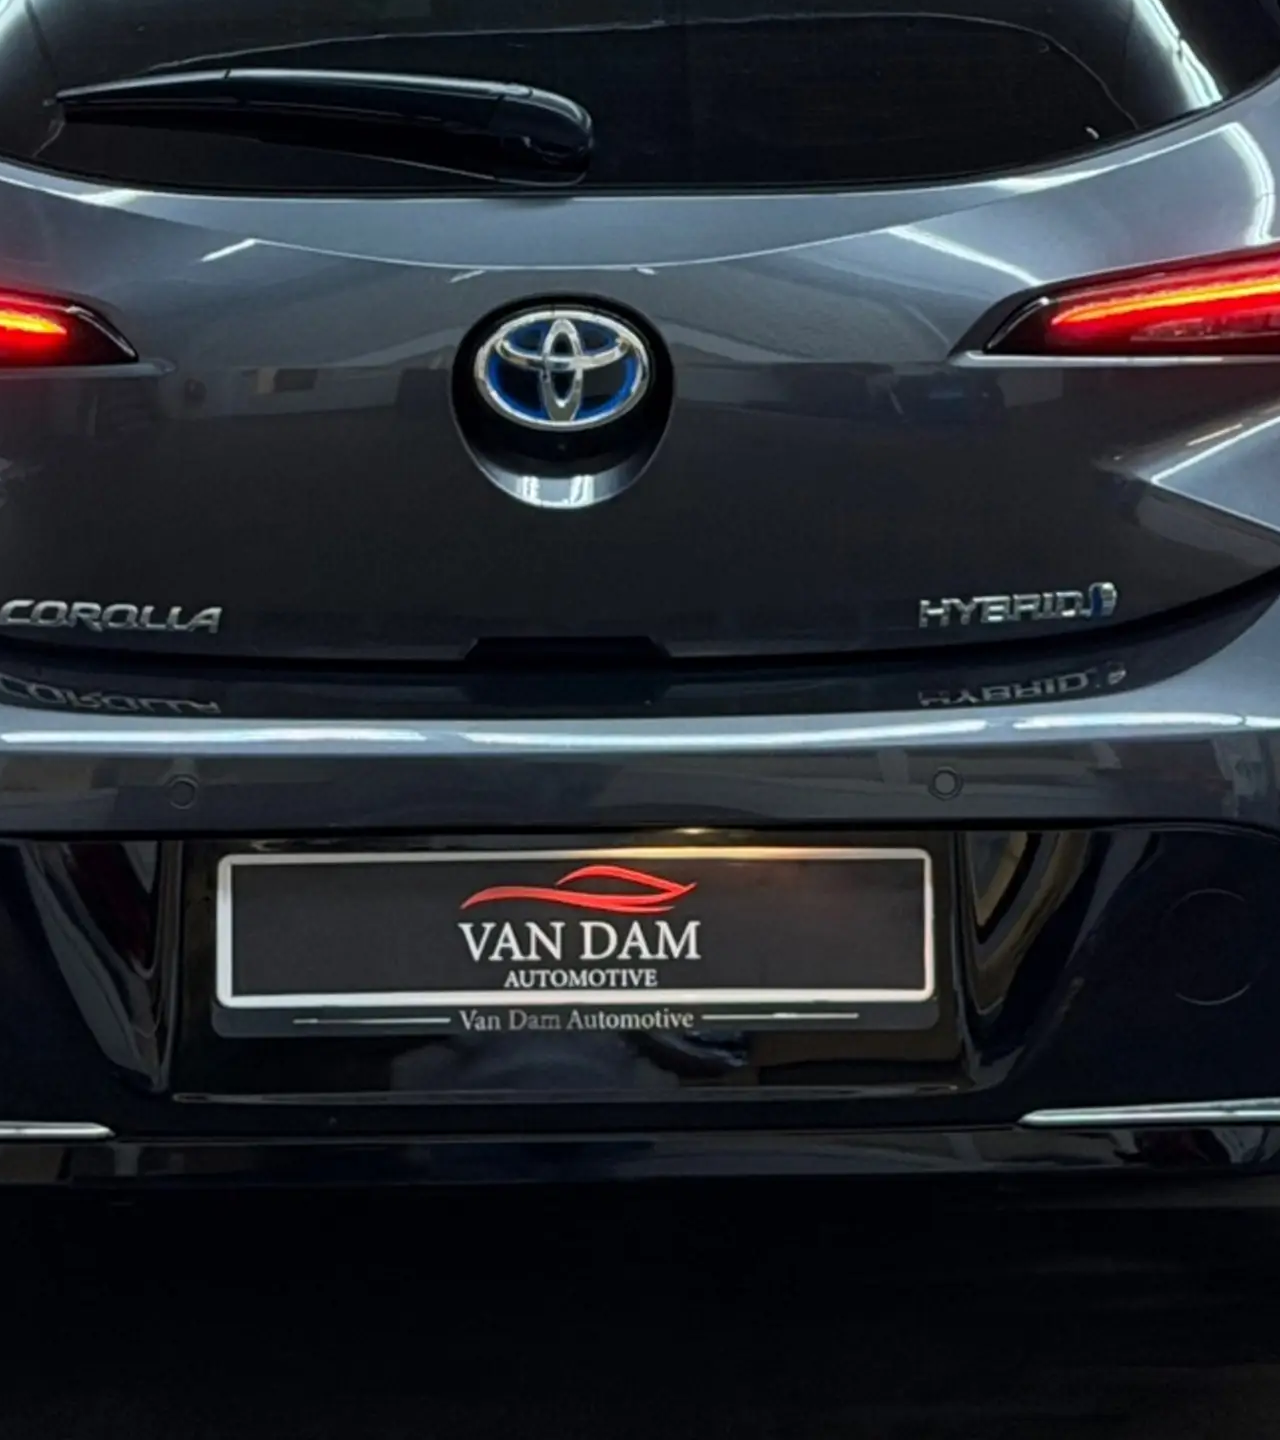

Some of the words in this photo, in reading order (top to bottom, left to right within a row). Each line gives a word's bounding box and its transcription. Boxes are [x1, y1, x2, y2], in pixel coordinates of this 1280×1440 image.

[919, 590, 1084, 628] HYBRID
[458, 921, 565, 961] VAN
[579, 920, 701, 960] DAM
[504, 968, 658, 988] AUTOMOTIVE
[459, 1010, 502, 1031] Van
[509, 1009, 562, 1030] Dam
[567, 1008, 695, 1030] Automotive
